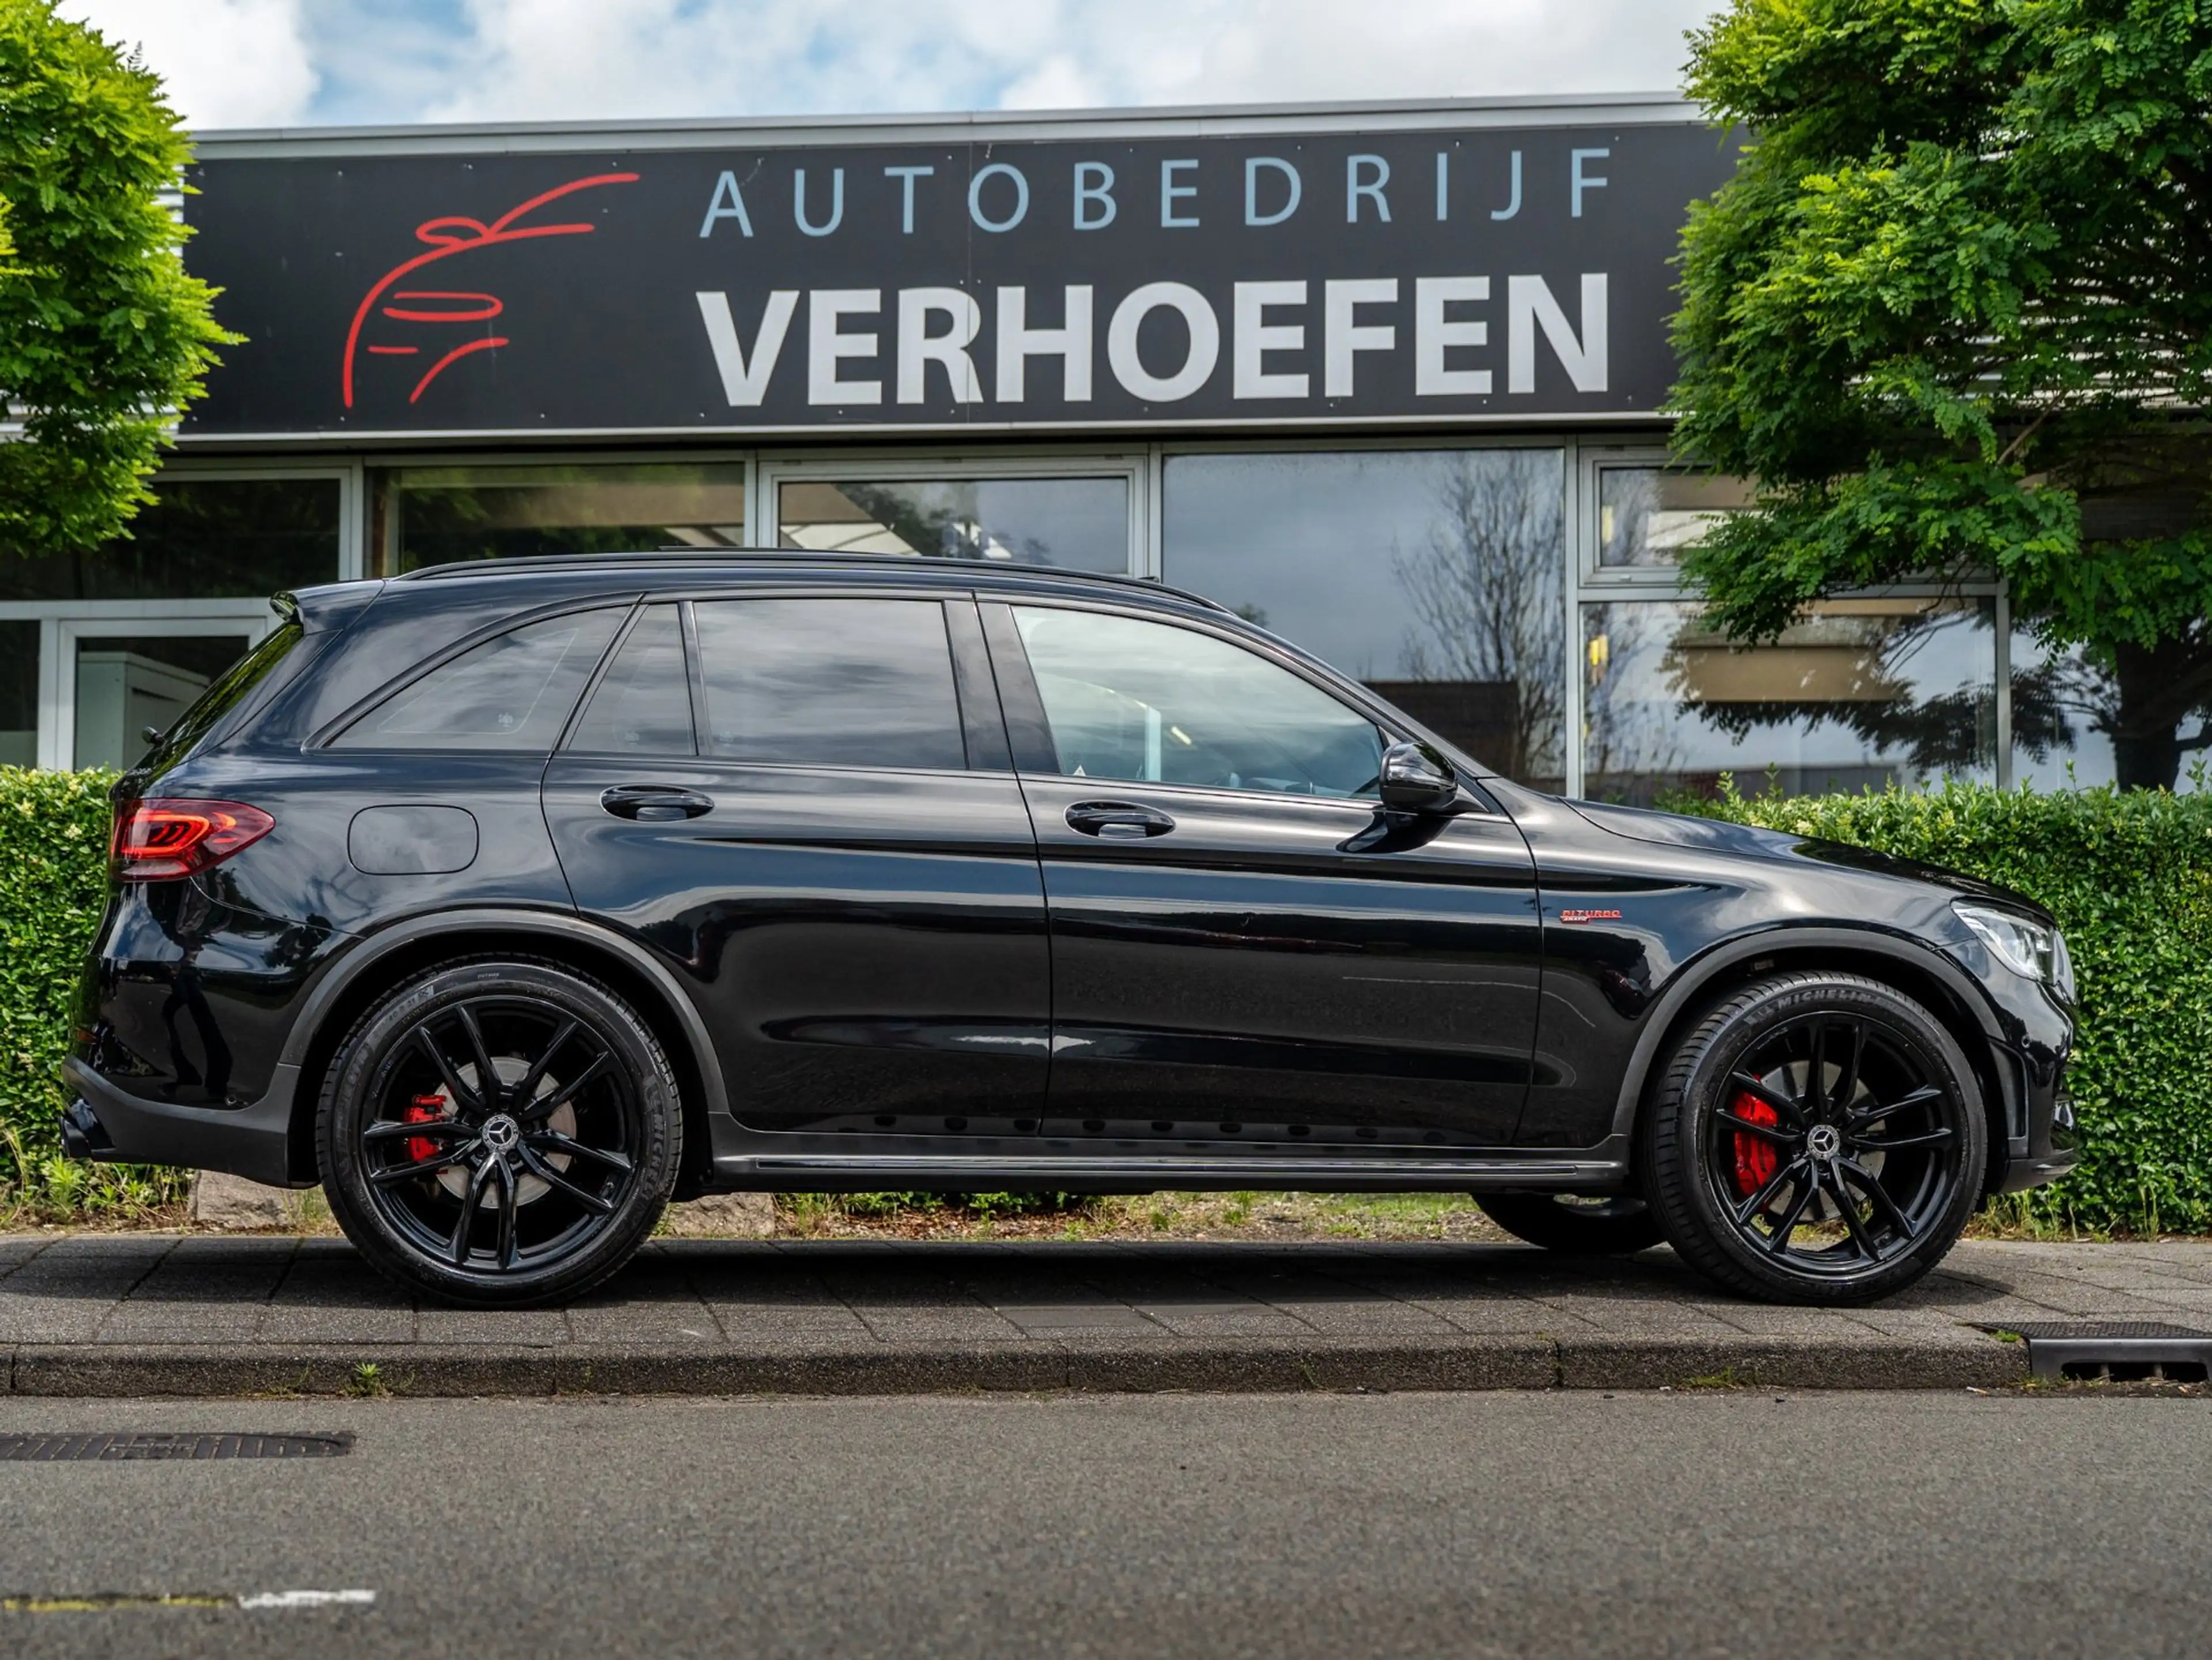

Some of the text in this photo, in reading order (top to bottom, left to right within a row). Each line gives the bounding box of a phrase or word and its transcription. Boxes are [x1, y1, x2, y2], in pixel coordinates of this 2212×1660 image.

[699, 148, 1610, 237] AUTOBEDRIJF
[695, 273, 1609, 407] VERHOEFEN
[1779, 989, 1875, 1009] MICHELIN
